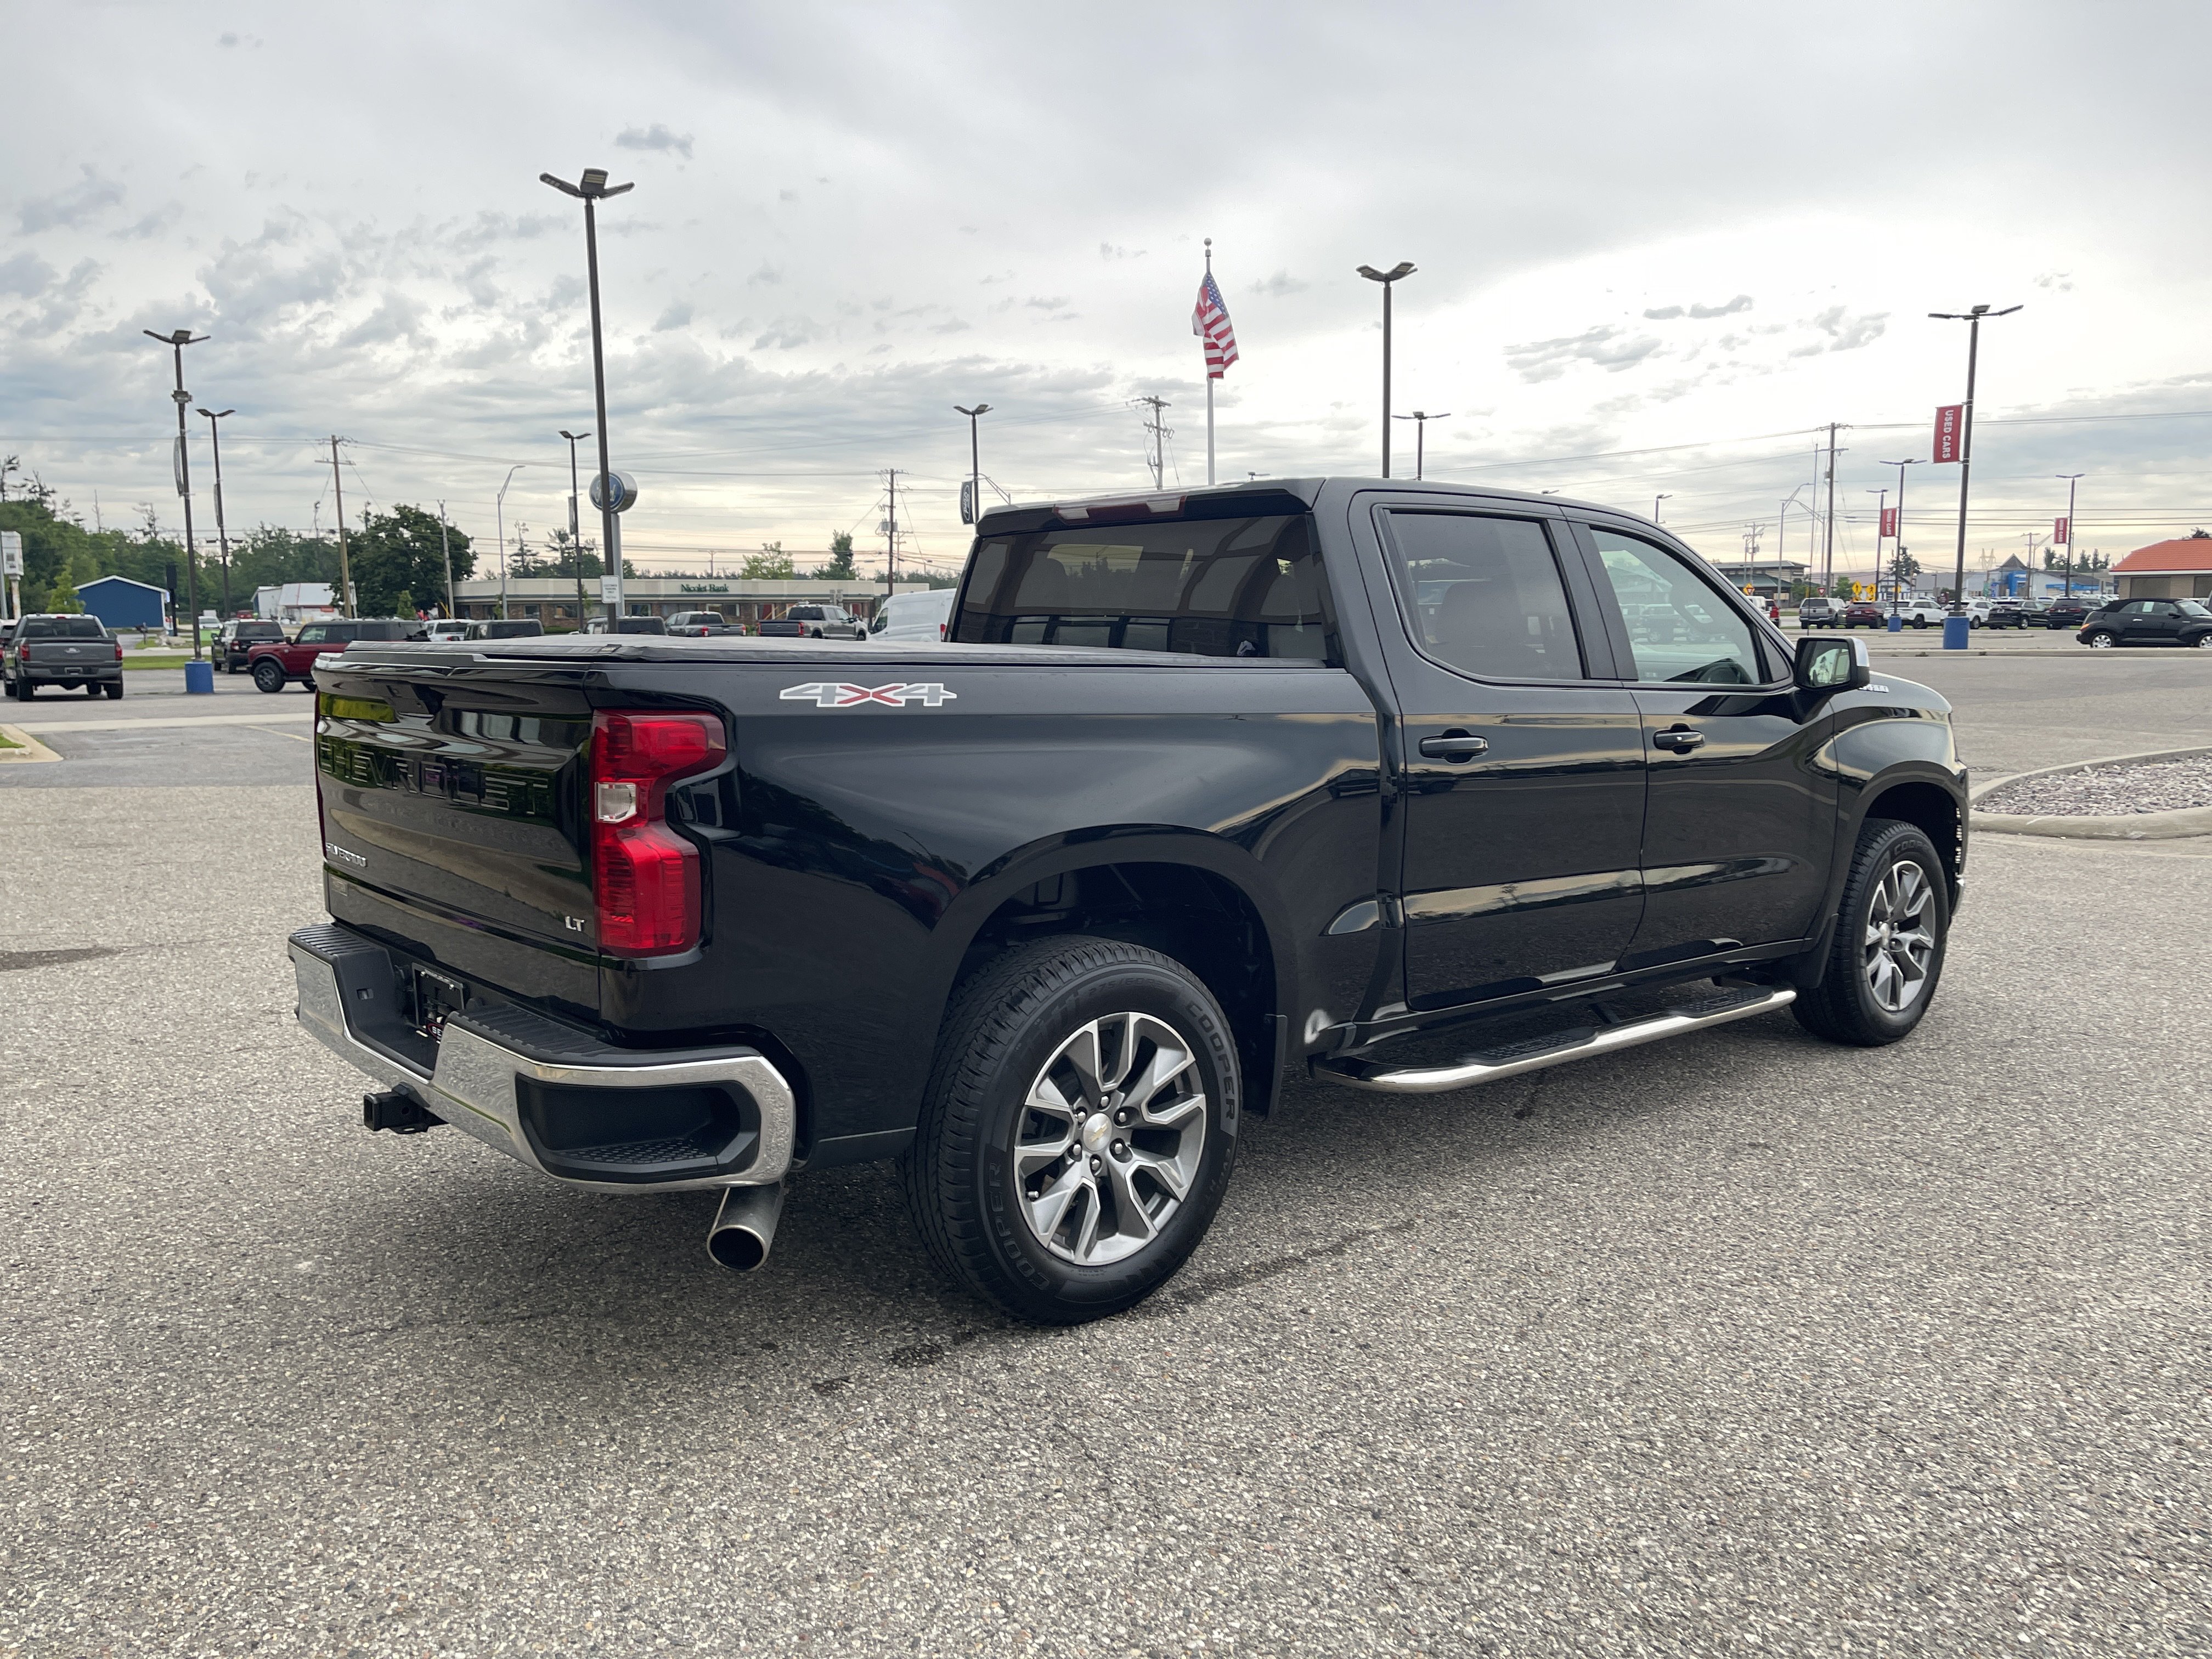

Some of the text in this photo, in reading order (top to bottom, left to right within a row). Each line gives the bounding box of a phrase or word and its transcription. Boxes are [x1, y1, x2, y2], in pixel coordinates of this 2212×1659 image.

[1942, 409, 1954, 459] USED CARS
[709, 584, 729, 592] Bank
[319, 741, 549, 815] CHEVROLET
[565, 916, 585, 932] LT
[1185, 1000, 1235, 1120] COOPER
[988, 1163, 1051, 1290] COOPER
